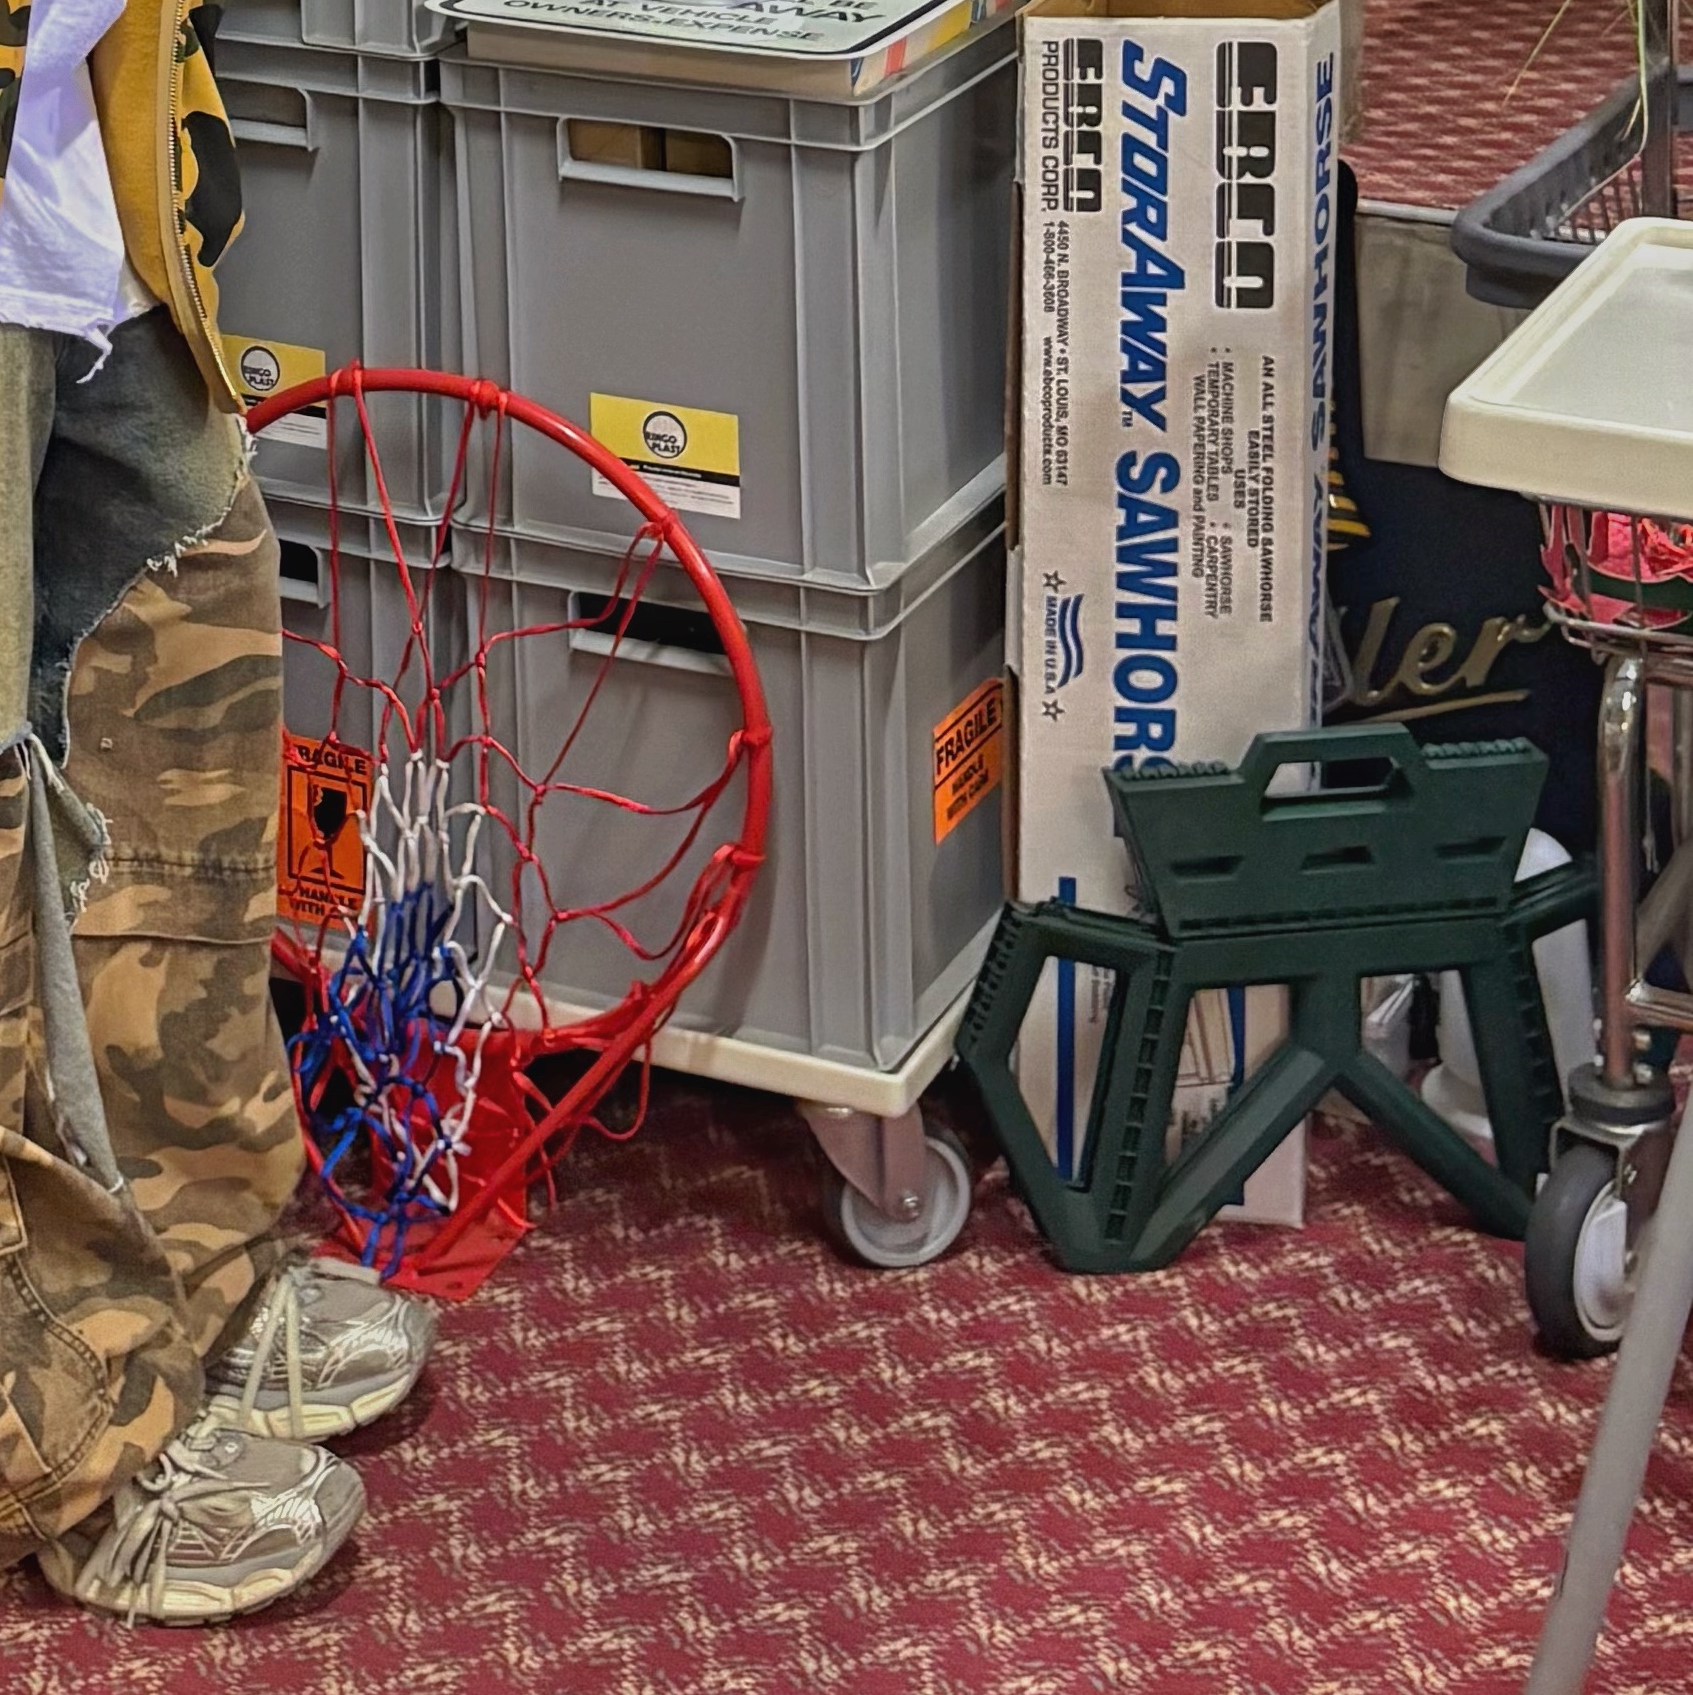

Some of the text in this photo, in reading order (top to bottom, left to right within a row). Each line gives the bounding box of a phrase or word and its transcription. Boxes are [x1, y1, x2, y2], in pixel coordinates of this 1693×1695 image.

[641, 3, 779, 25] VEHICLE
[1040, 40, 1060, 213] PRODUCTS CORP.
[1057, 220, 1069, 250] 4450
[1057, 253, 1069, 267] N.
[1057, 269, 1069, 346] BROADWAY
[1056, 379, 1069, 422] LOUIS,
[1057, 356, 1069, 377] ST.
[1057, 424, 1069, 448] MO
[1207, 361, 1220, 502] TEMPORARY TABLES
[1221, 361, 1234, 475] MACHINE SHOPS
[1192, 374, 1206, 579] WALL PAPERING and PAINTING
[1234, 468, 1246, 509] USES
[1248, 429, 1260, 549] EASILY STORED
[1260, 355, 1275, 623] AN ALL STEEL FOLDING SAWHORSE
[1112, 450, 1181, 774] SAWHOR
[1205, 535, 1219, 619] CARPENTRY
[1219, 535, 1233, 615] SAWHORSE
[1045, 595, 1057, 637] MADE
[1045, 639, 1057, 656] IN
[297, 744, 367, 776] RAGILE
[935, 697, 997, 776] FRAGILE
